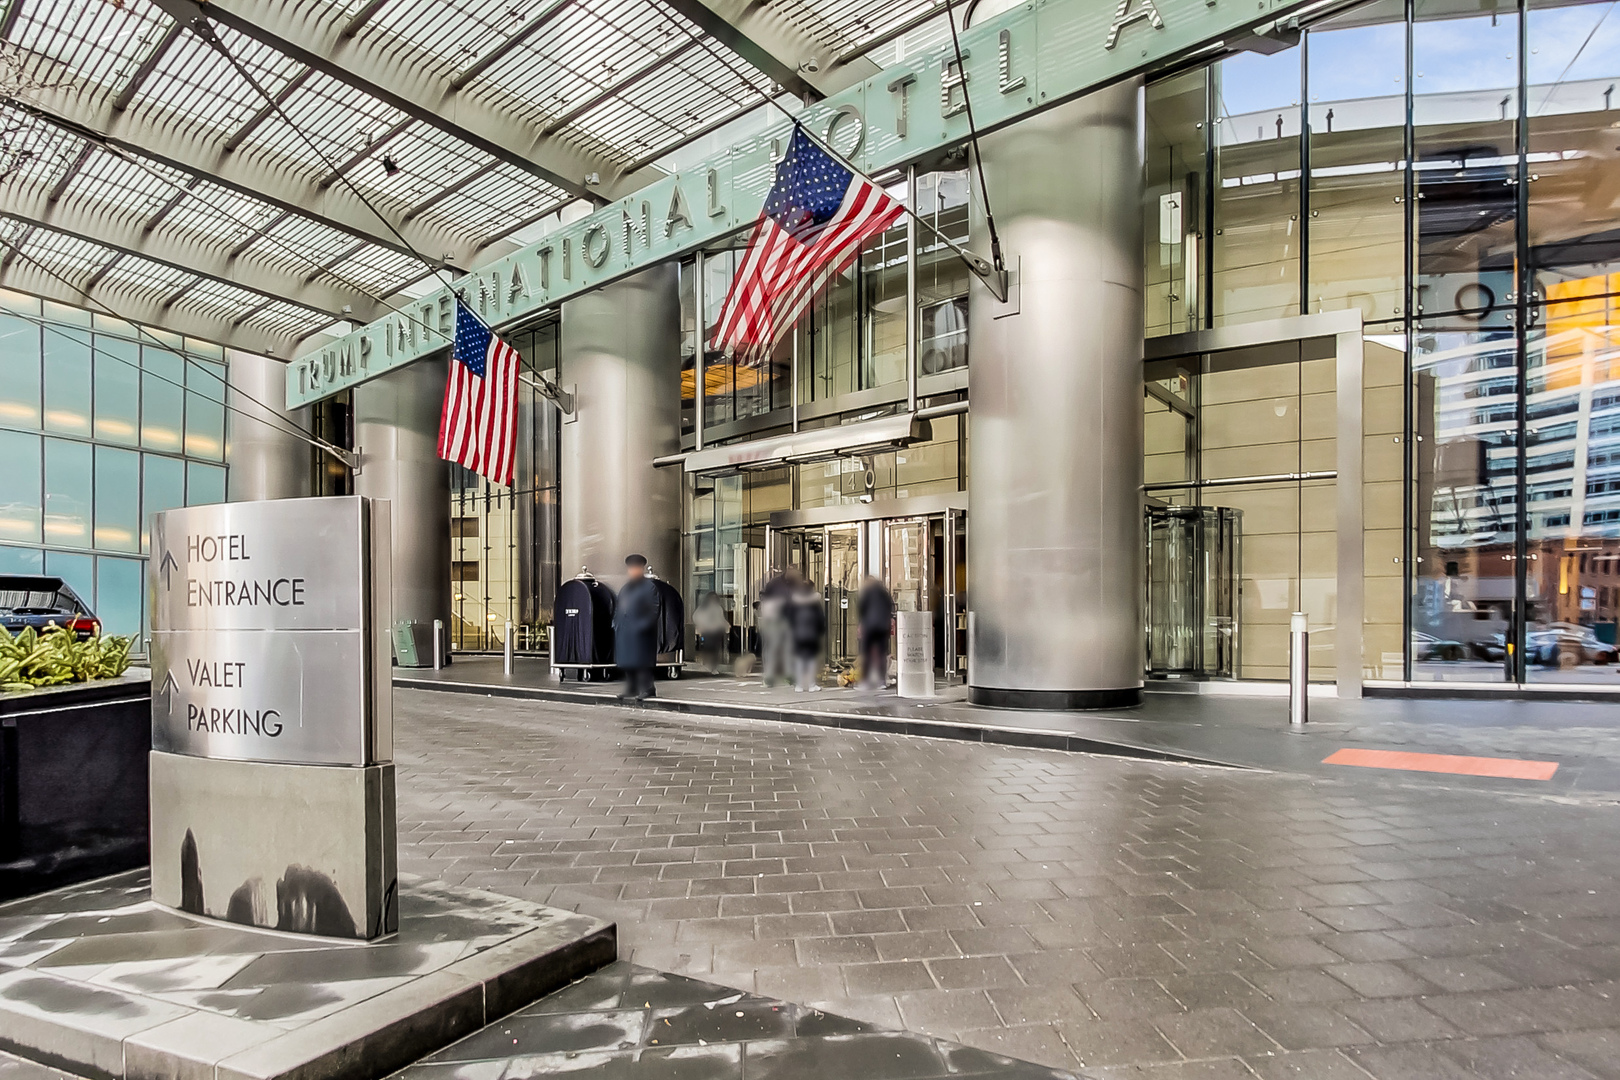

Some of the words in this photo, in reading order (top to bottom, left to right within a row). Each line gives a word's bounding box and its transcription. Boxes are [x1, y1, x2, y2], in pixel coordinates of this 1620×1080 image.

[297, 335, 373, 395] TRUMP
[187, 534, 251, 563] HOTEL
[187, 578, 305, 607] ENTRANCE
[187, 658, 246, 689] VALET
[187, 703, 283, 738] PARKING
